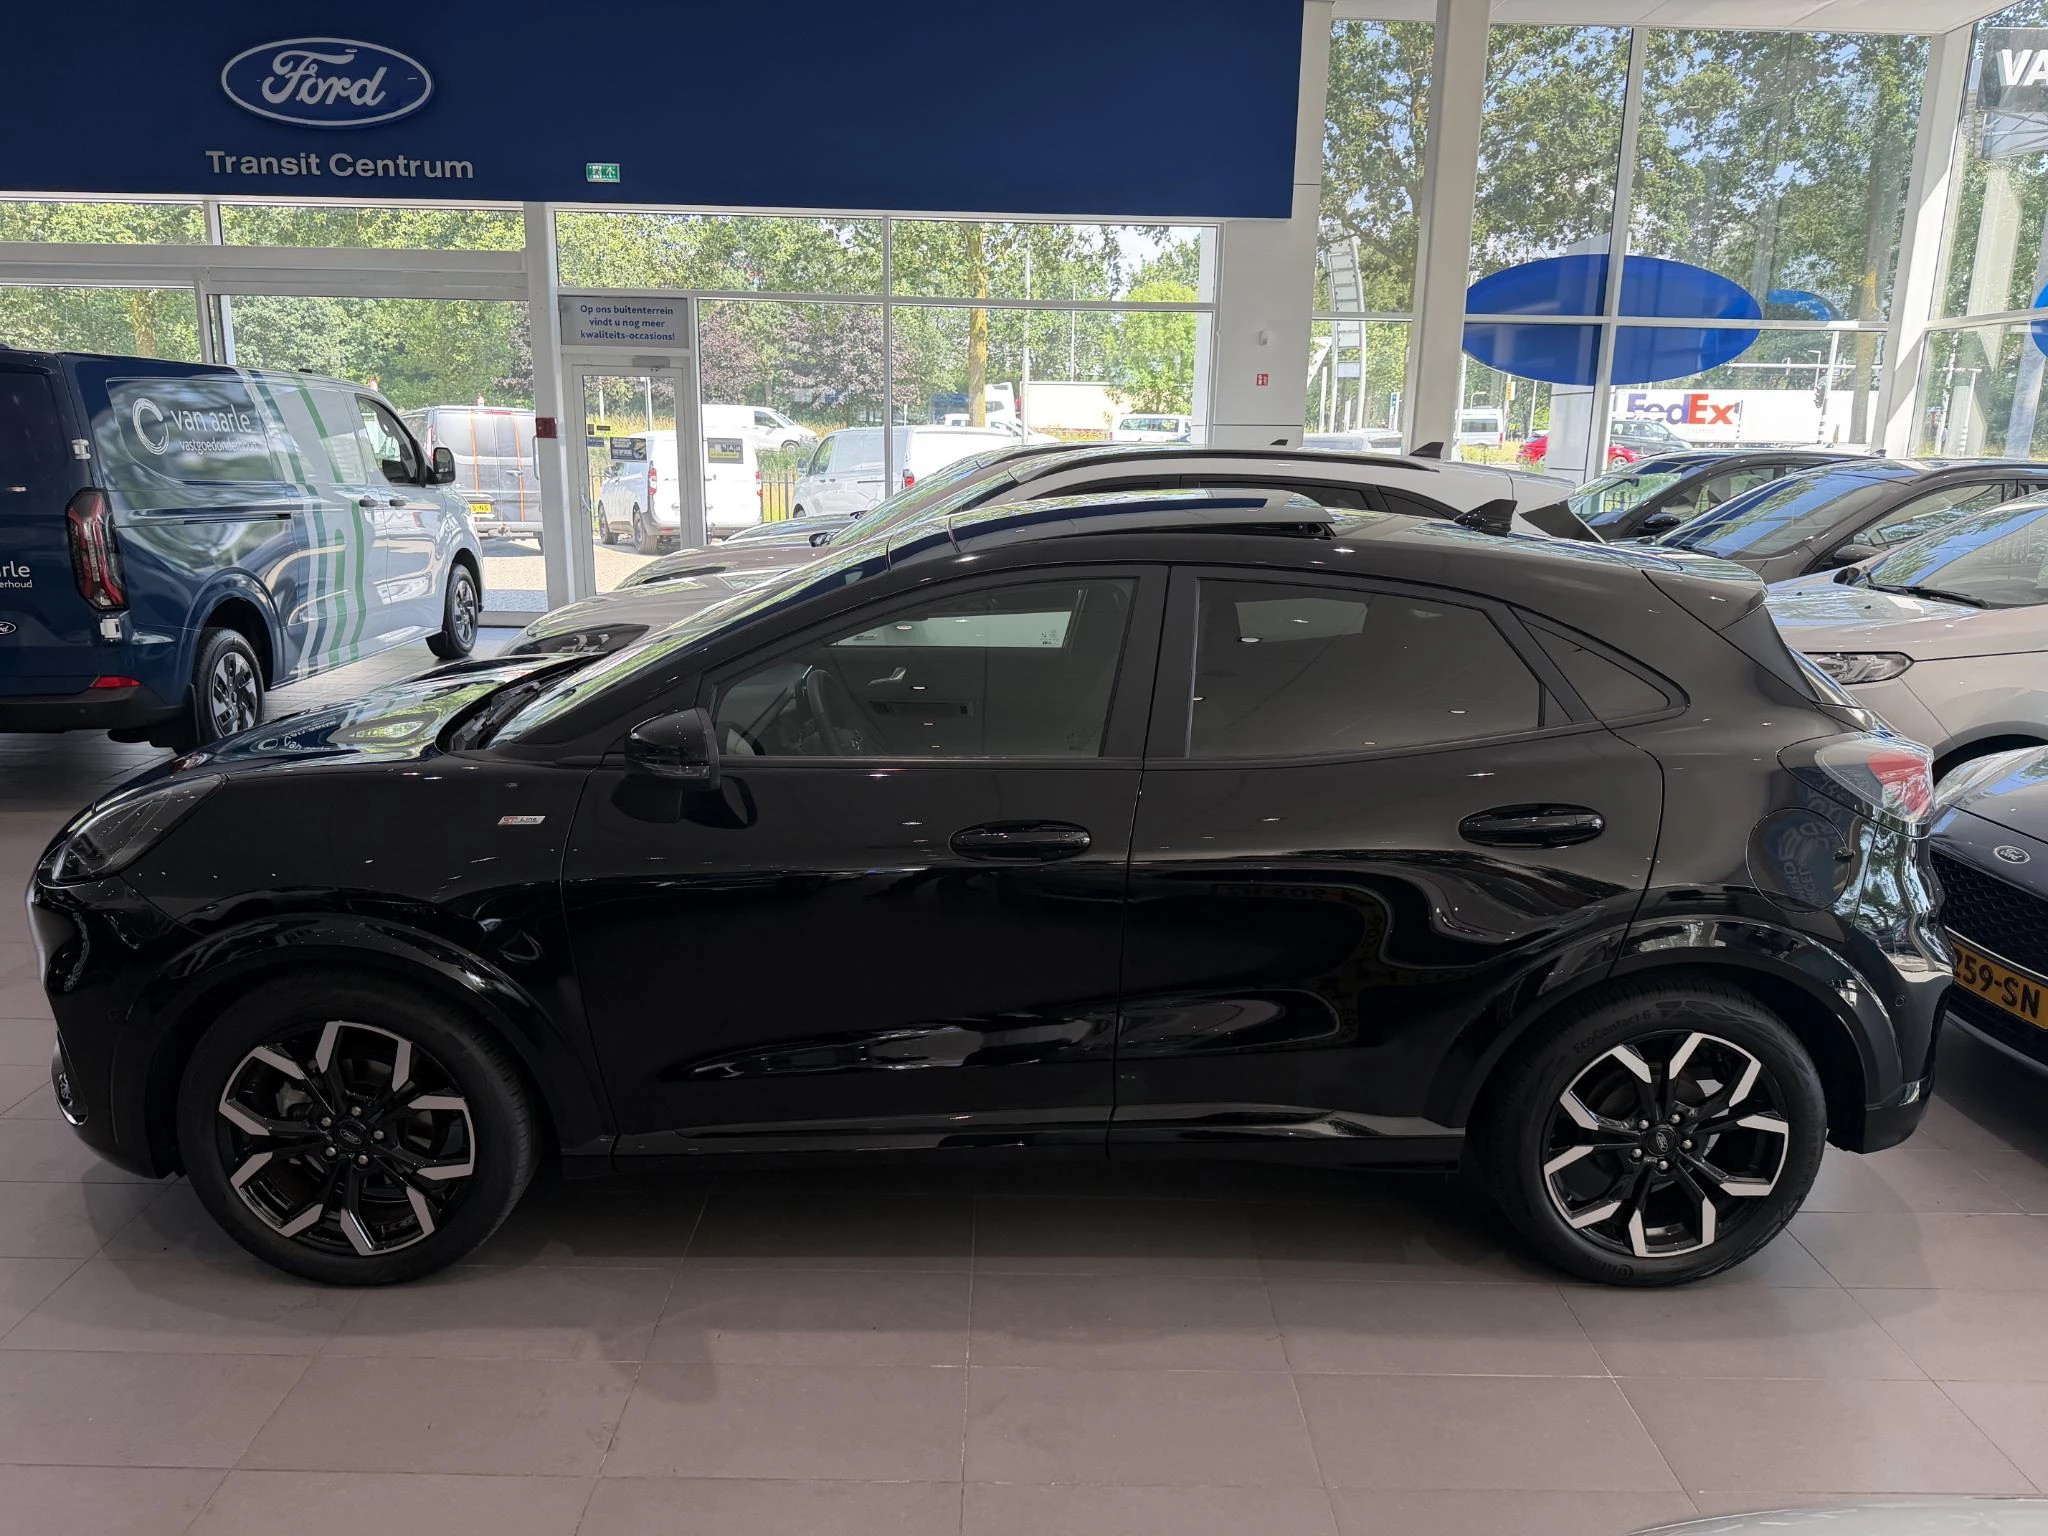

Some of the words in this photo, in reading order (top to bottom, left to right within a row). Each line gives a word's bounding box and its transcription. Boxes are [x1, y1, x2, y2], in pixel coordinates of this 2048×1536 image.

[261, 49, 388, 106] Ford
[205, 150, 321, 176] Transit
[329, 153, 474, 178] Centrum
[580, 304, 593, 315] Op
[613, 305, 674, 315] buitenterrein
[589, 317, 613, 326] vindt
[622, 319, 640, 329] nog
[580, 330, 675, 340] kwaliteits-occasions!
[170, 409, 207, 431] van
[209, 403, 252, 433] aarle
[1626, 393, 1737, 425] FedEx
[2000, 848, 2022, 860] Ford
